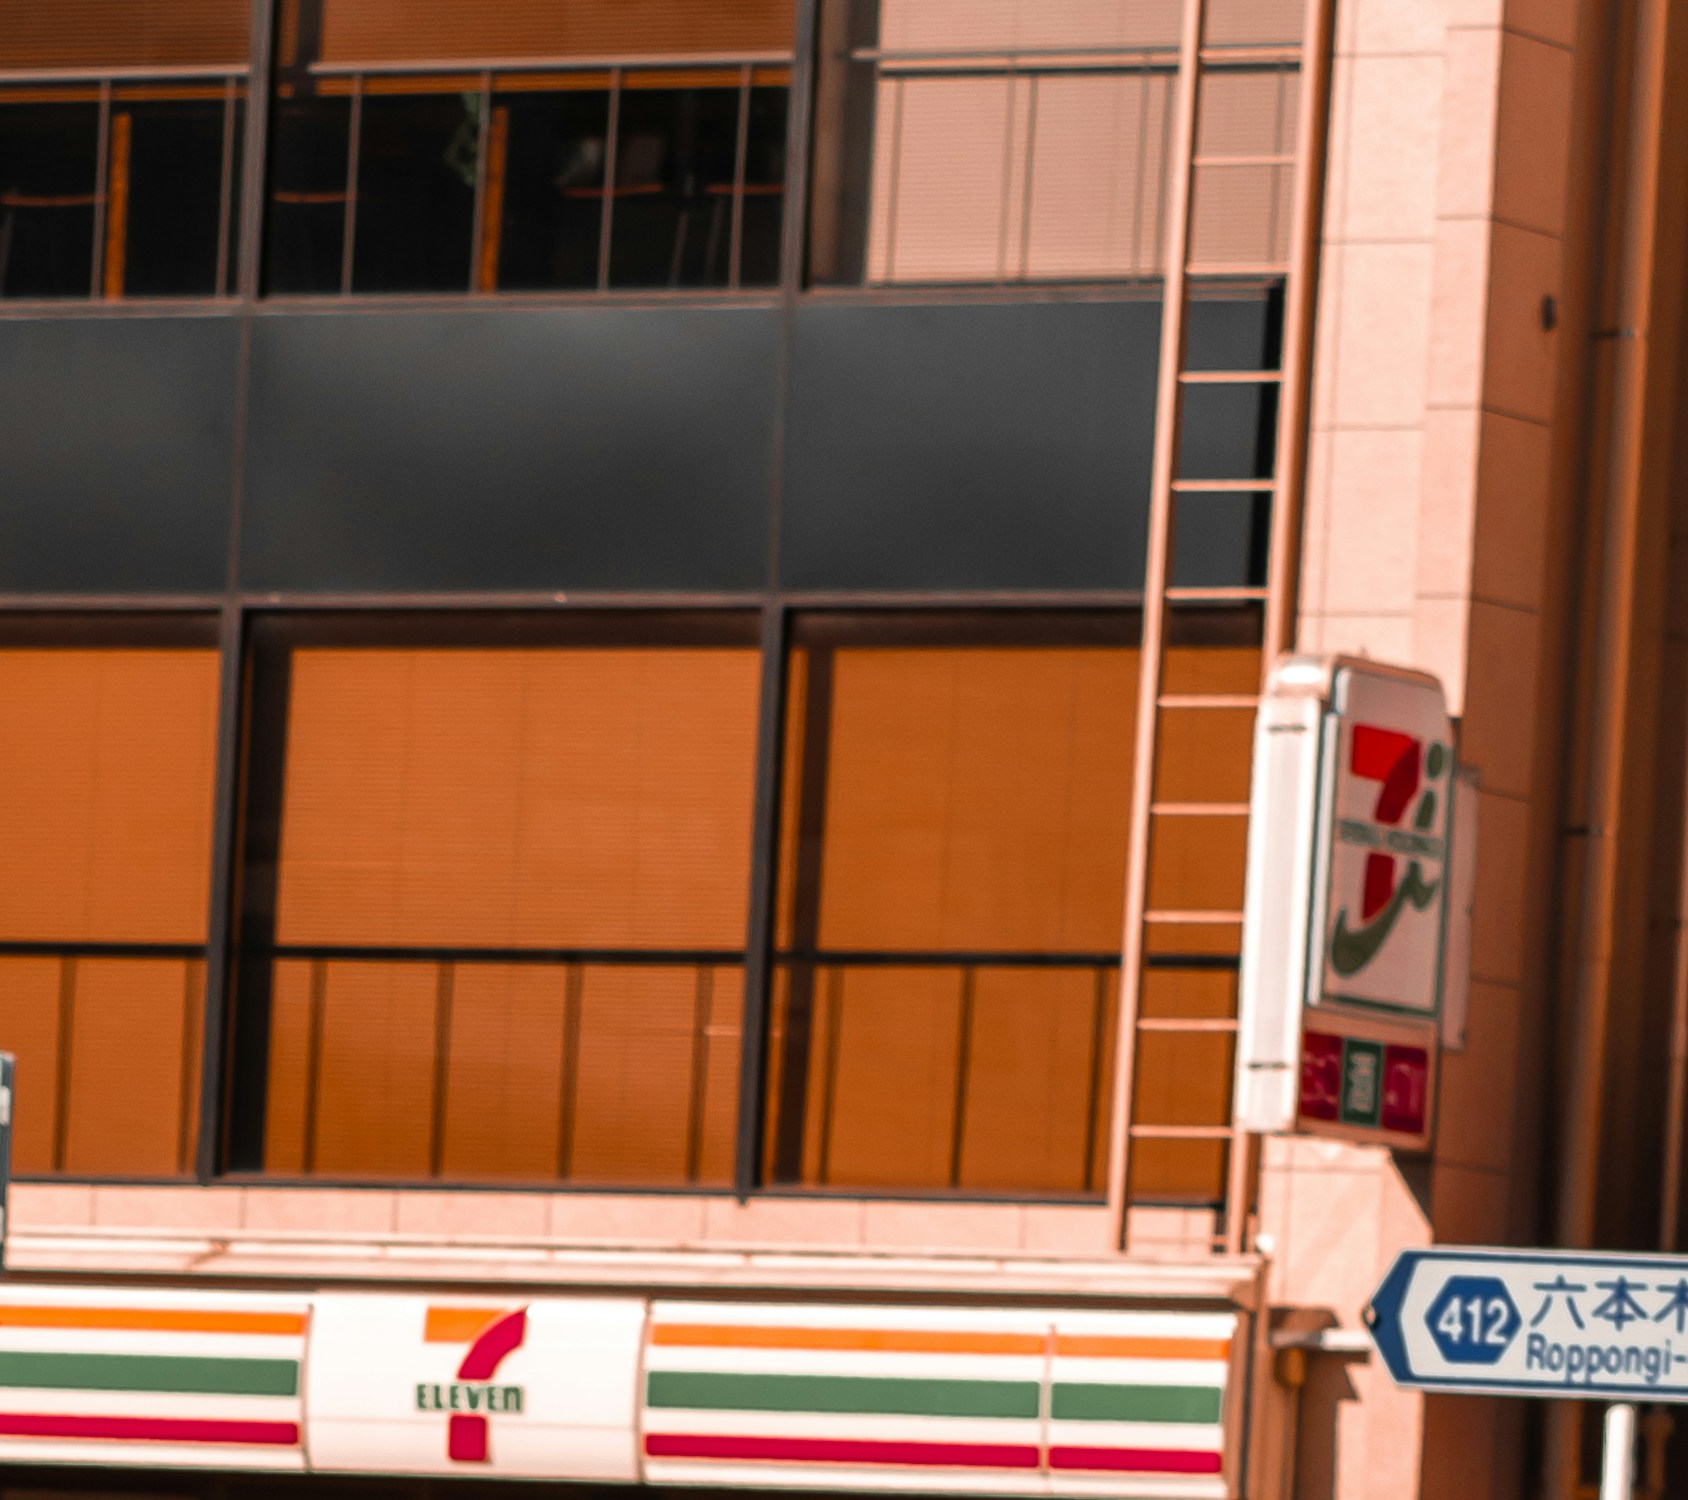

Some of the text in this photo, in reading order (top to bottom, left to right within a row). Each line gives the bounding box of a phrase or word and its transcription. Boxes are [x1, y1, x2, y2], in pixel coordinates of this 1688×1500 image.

[1438, 1296, 1510, 1345] 412
[424, 1306, 527, 1462] 7
[1526, 1332, 1688, 1385] Roppongi-
